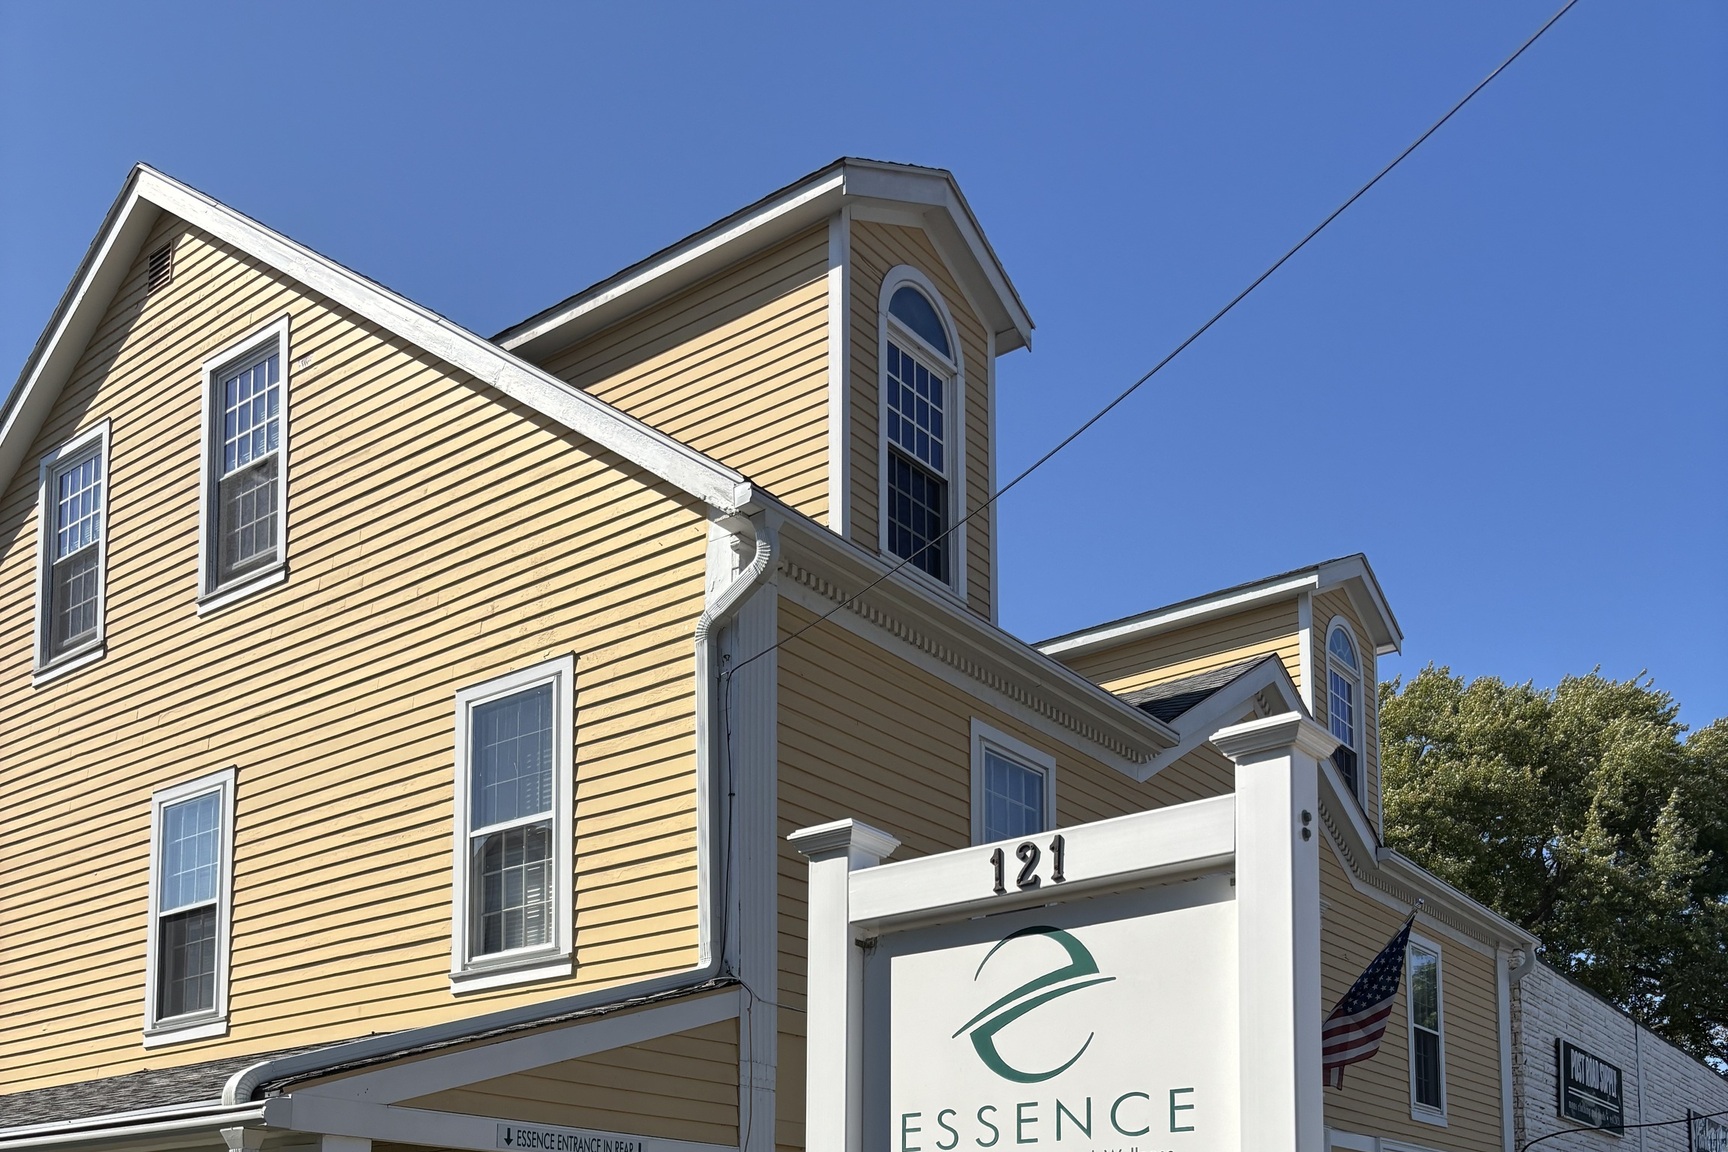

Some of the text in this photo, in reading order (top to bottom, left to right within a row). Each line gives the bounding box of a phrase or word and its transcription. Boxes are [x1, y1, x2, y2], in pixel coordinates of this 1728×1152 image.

[989, 835, 1066, 894] 121
[516, 1130, 555, 1150] ESSENCE
[901, 1087, 1195, 1152] ESSENCE
